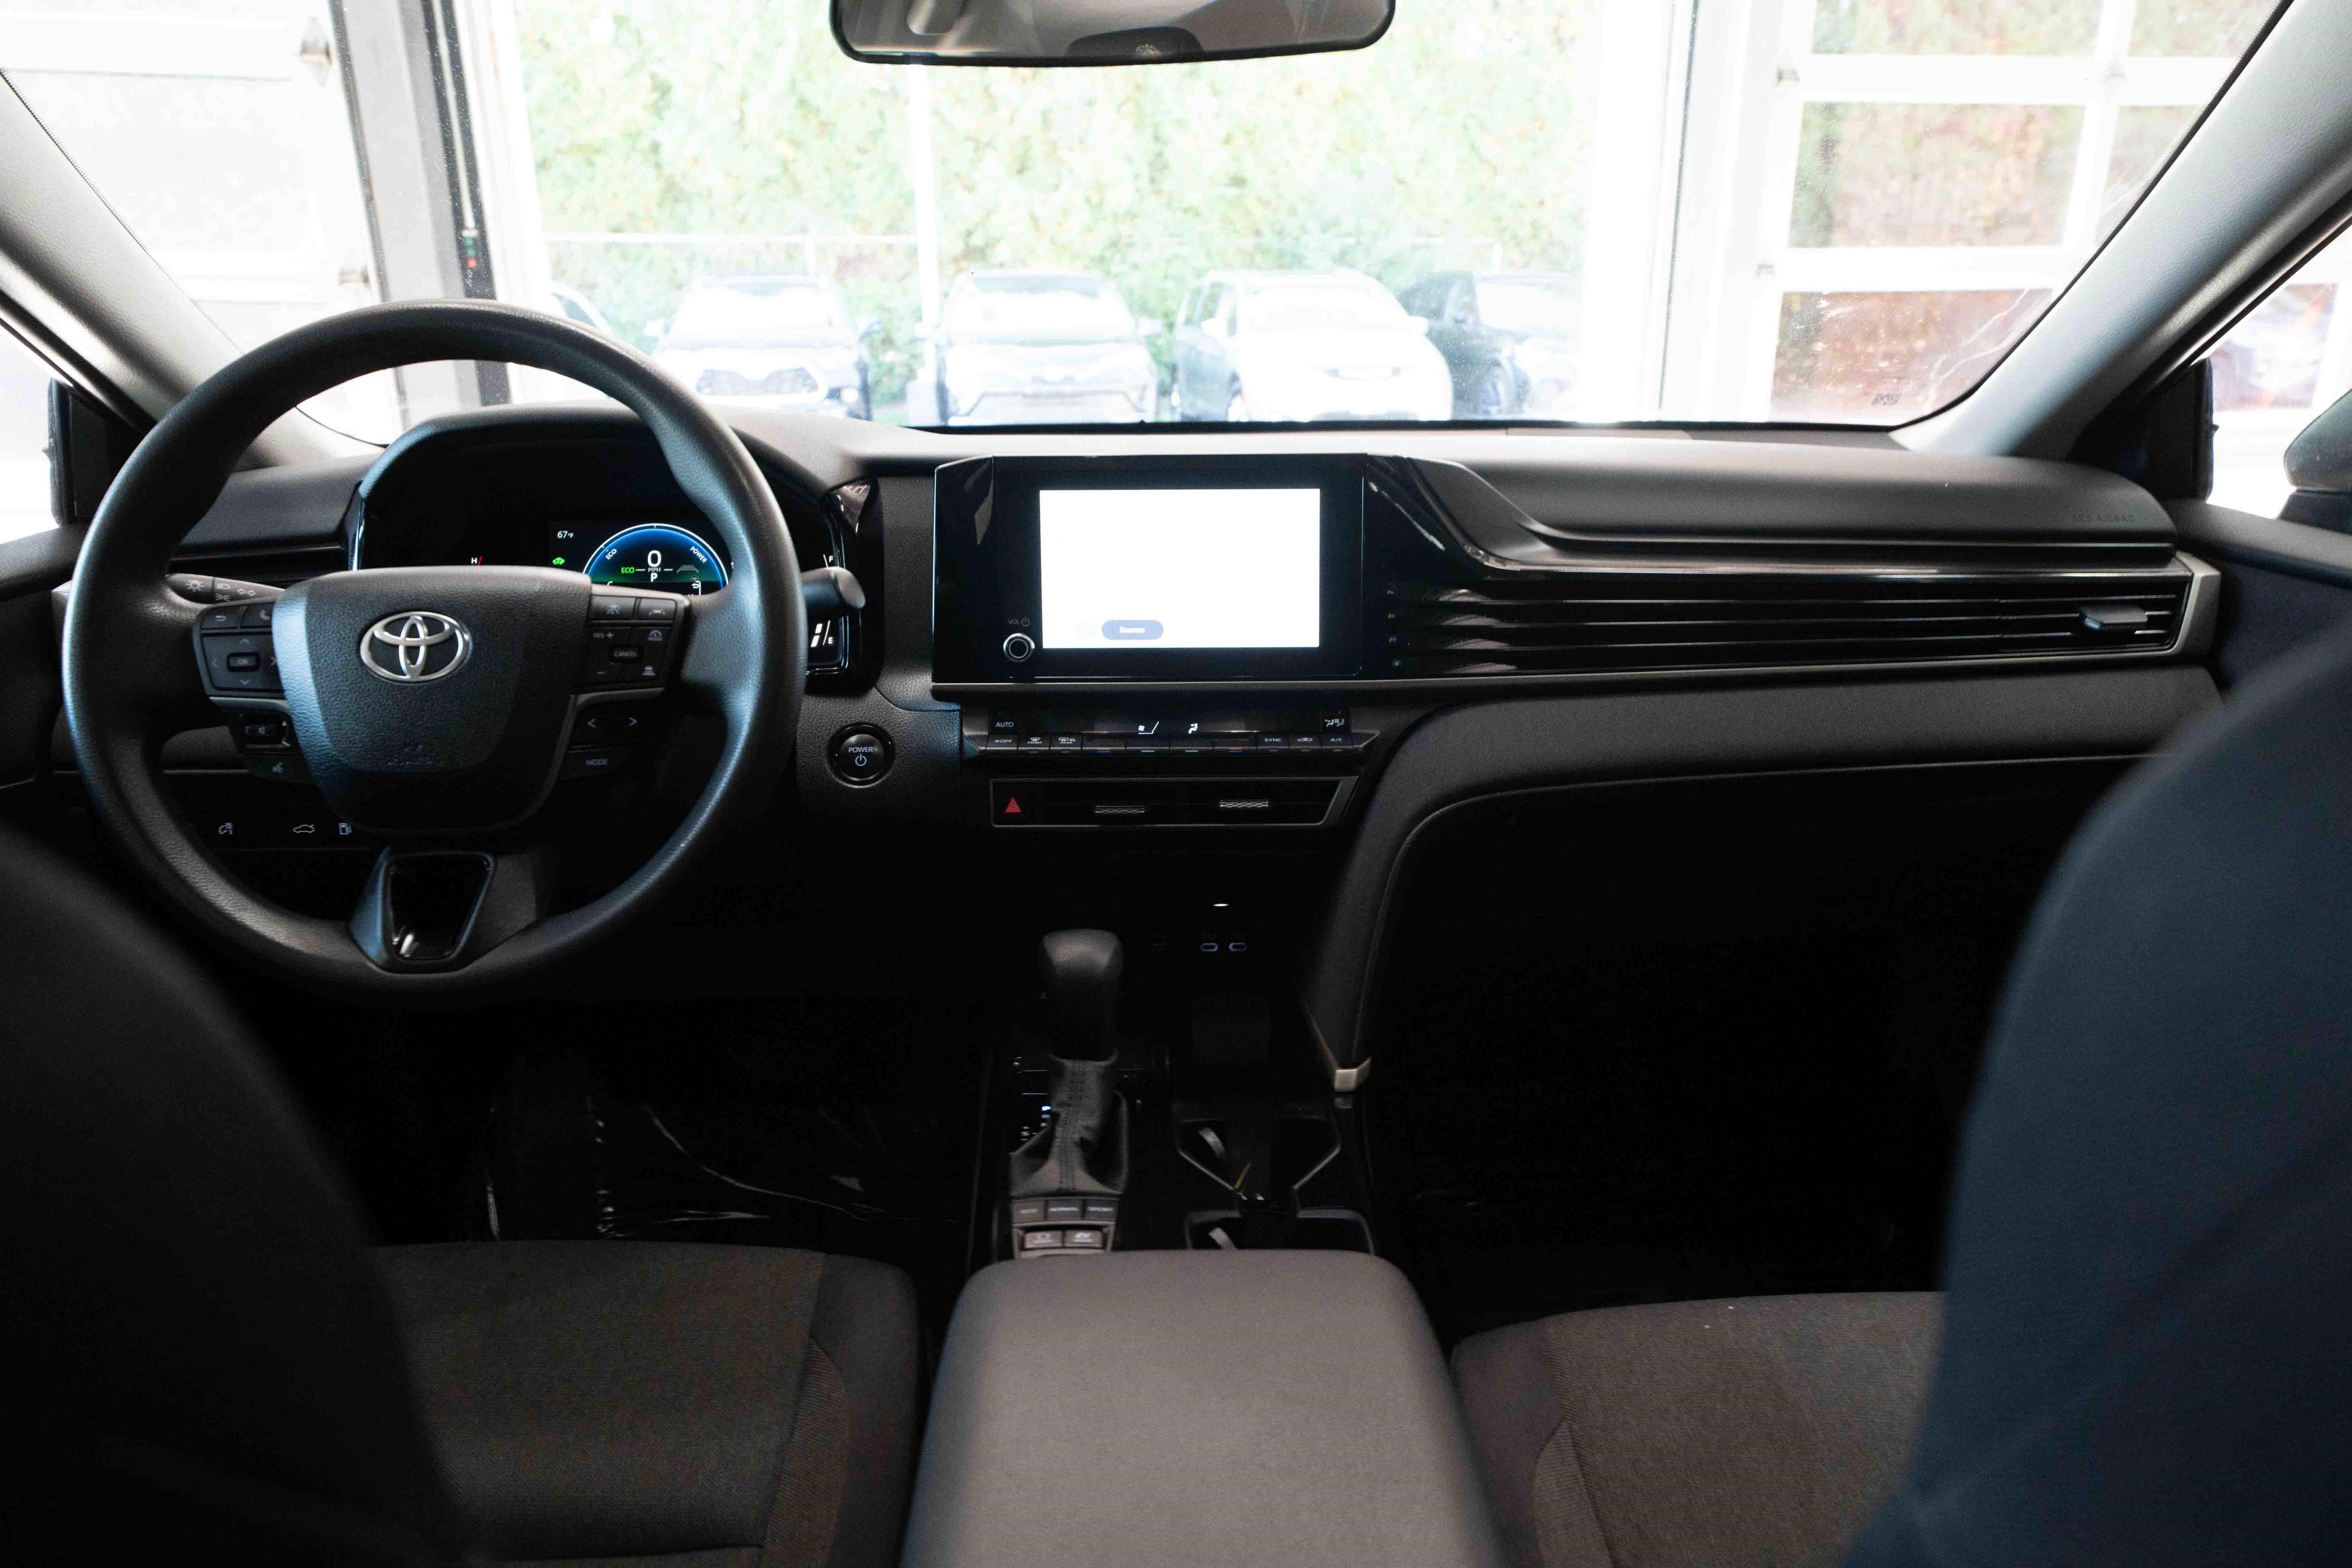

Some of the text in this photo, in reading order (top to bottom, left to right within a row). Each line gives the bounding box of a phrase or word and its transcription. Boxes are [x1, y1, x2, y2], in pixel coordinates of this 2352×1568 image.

[605, 548, 617, 560] ECO
[648, 550, 662, 568] 0
[690, 546, 707, 564] POWER
[650, 572, 658, 583] P
